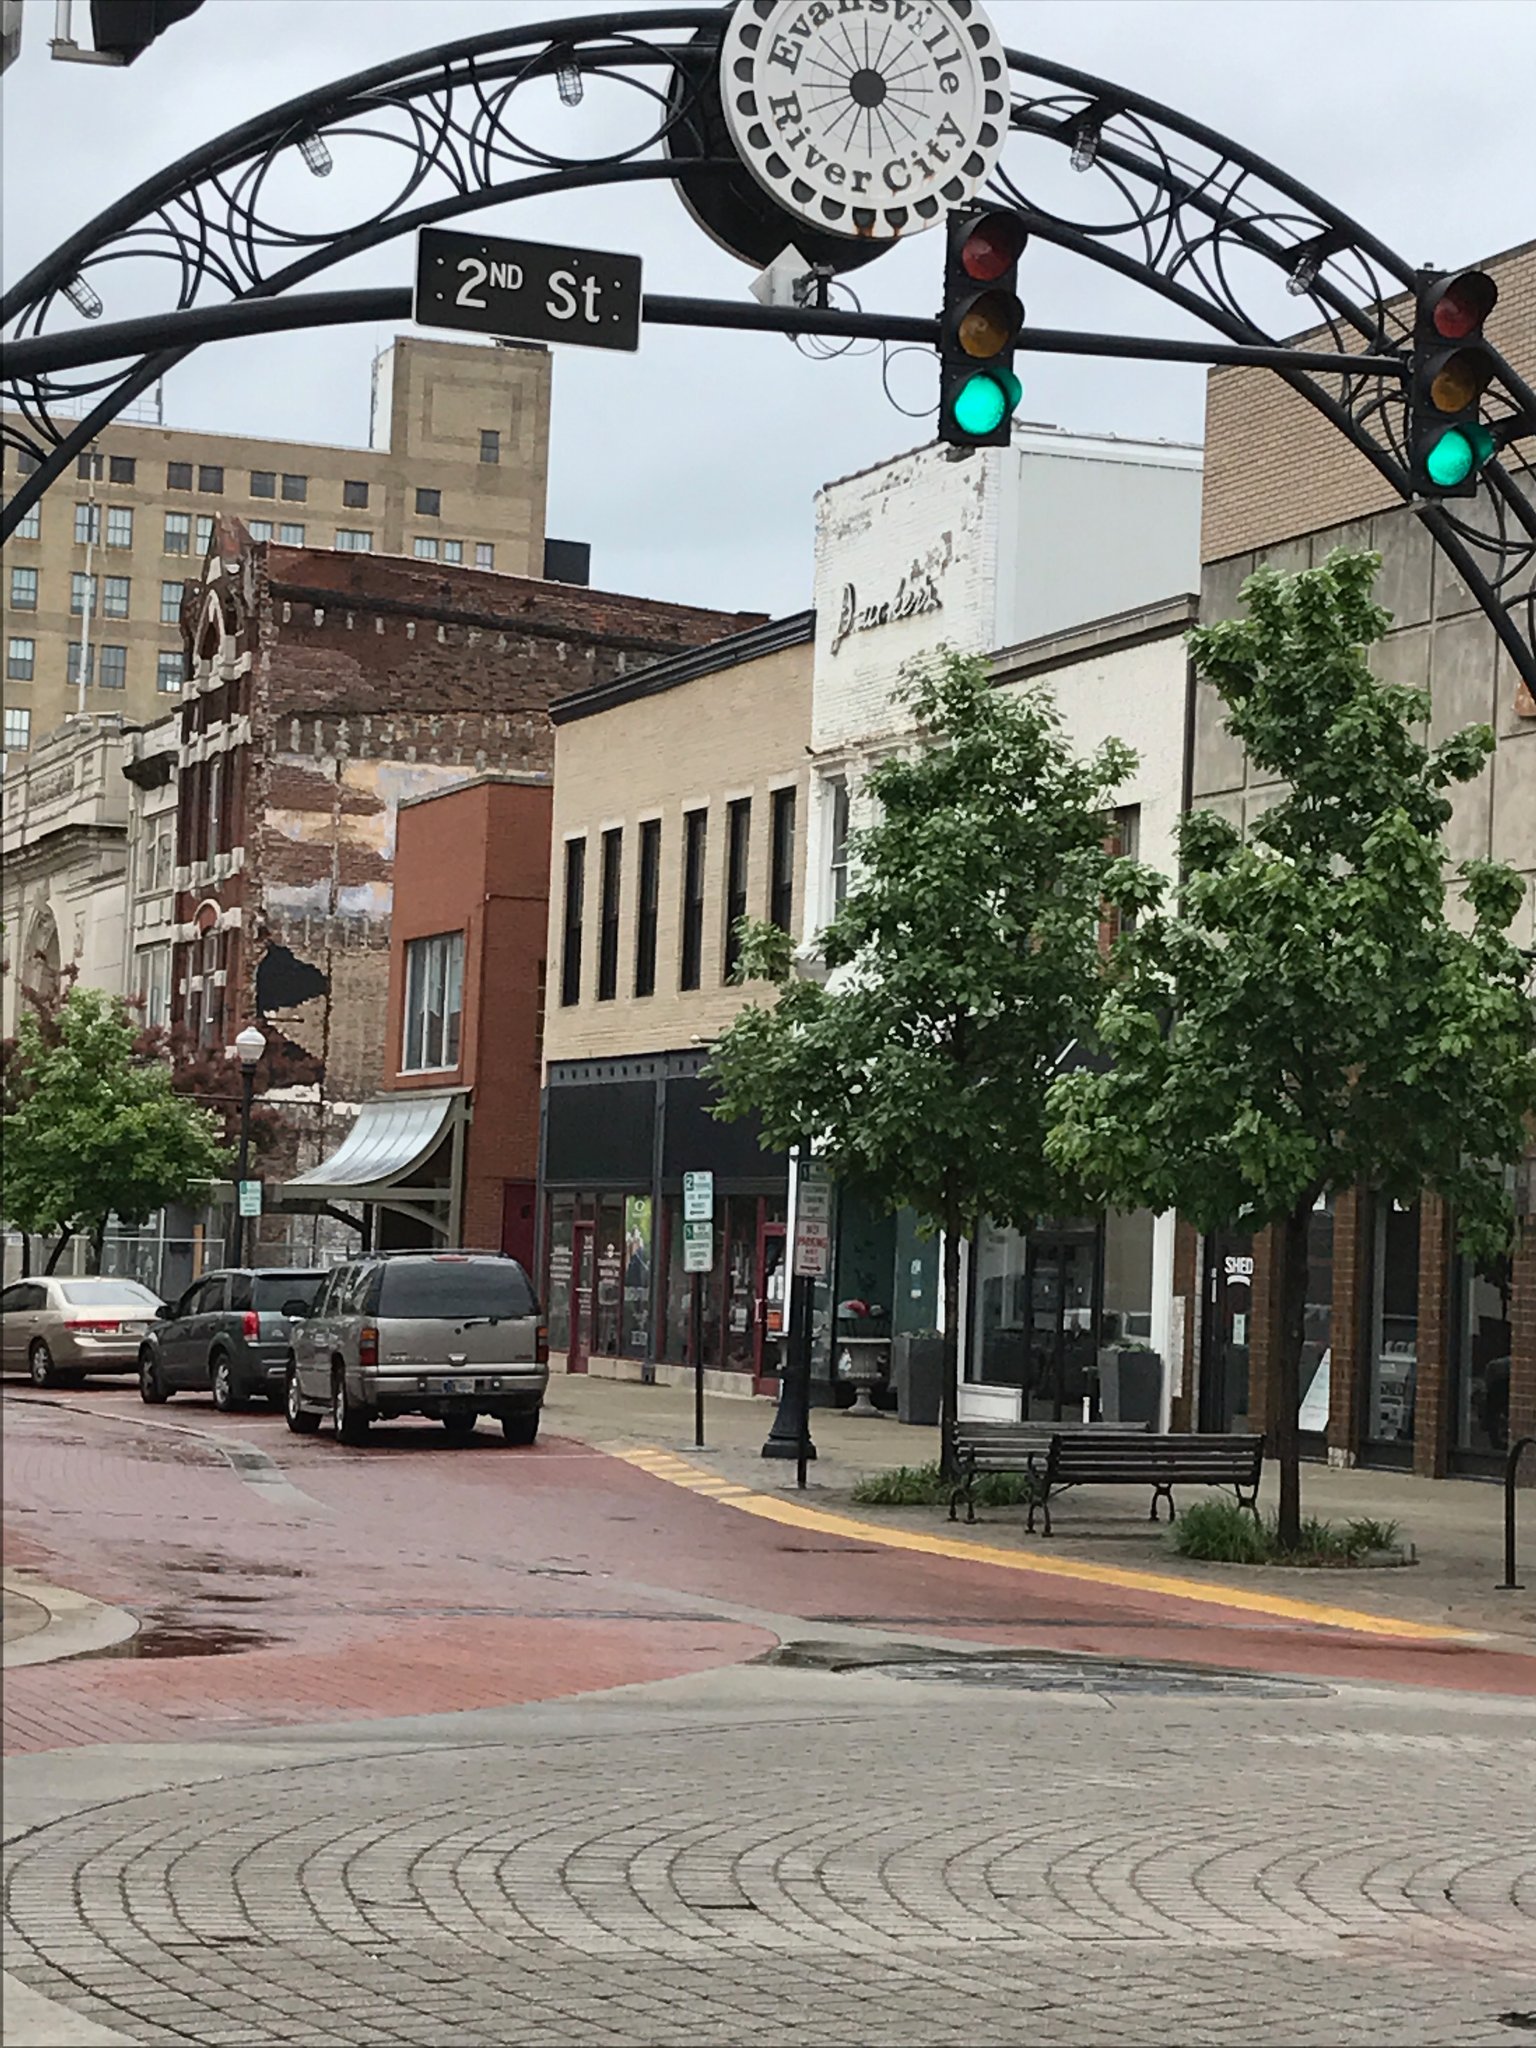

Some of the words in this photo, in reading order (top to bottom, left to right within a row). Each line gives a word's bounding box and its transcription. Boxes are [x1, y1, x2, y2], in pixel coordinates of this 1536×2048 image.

[767, 0, 962, 95] Evansville
[768, 90, 872, 193] River
[882, 112, 967, 193] City
[455, 257, 524, 309] 2ND
[545, 269, 602, 323] St
[1224, 1256, 1254, 1275] SHED
